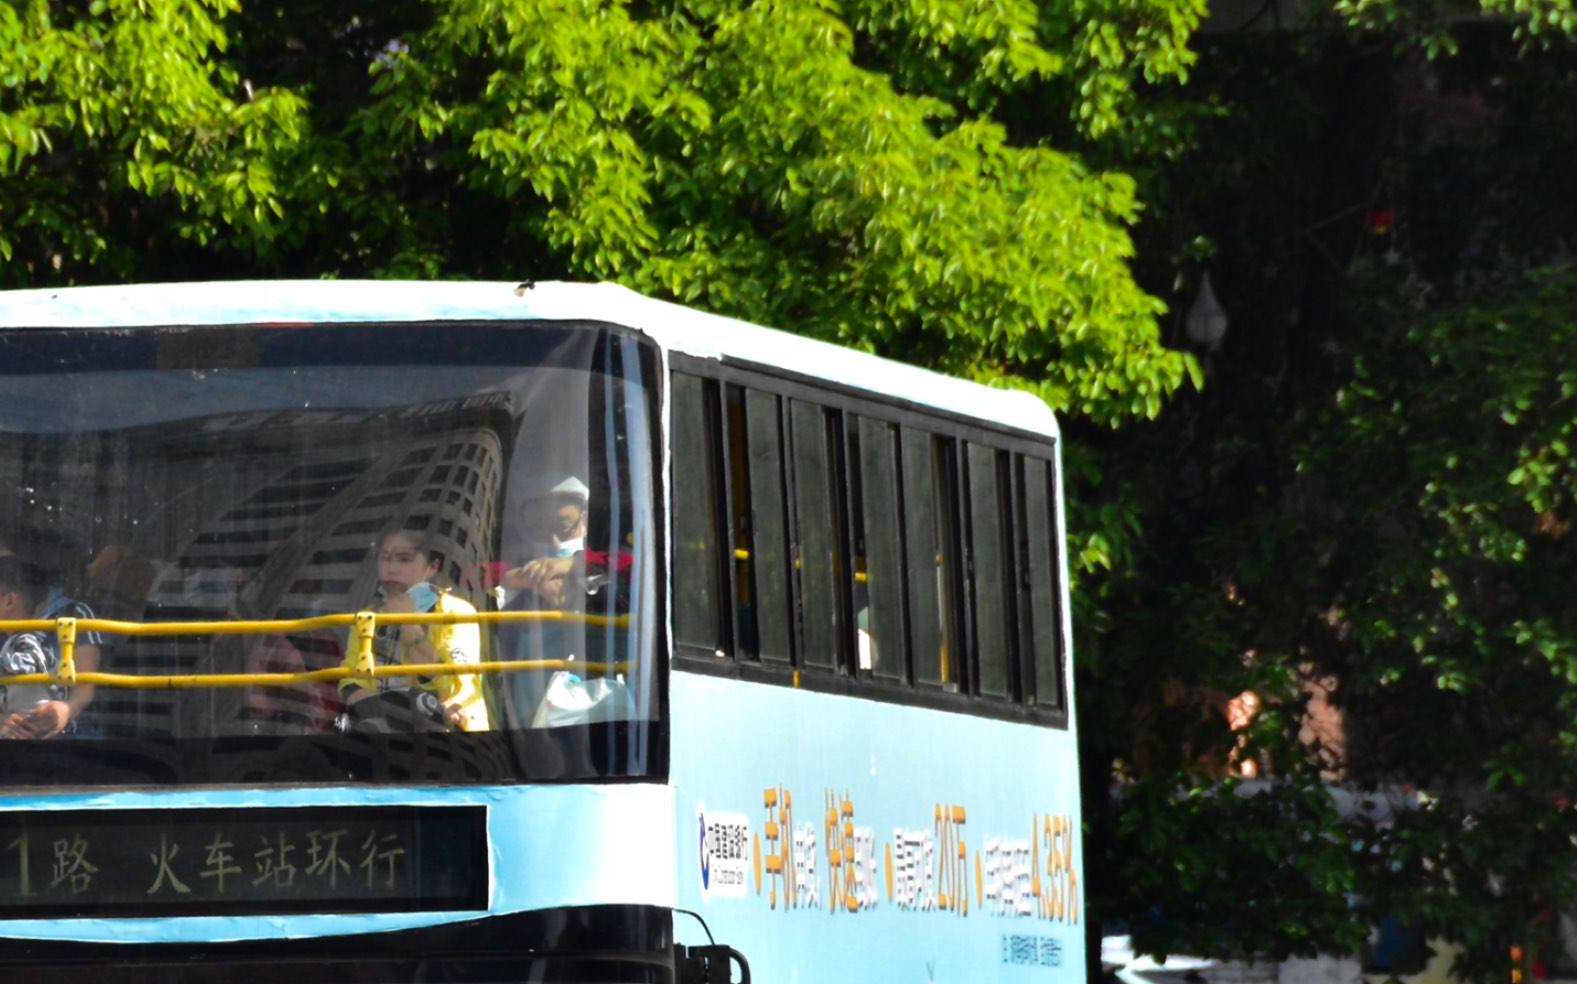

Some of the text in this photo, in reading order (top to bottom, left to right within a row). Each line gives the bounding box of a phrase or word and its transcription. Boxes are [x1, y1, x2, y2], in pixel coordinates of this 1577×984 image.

[8, 828, 405, 897] 1路 火车站环行
